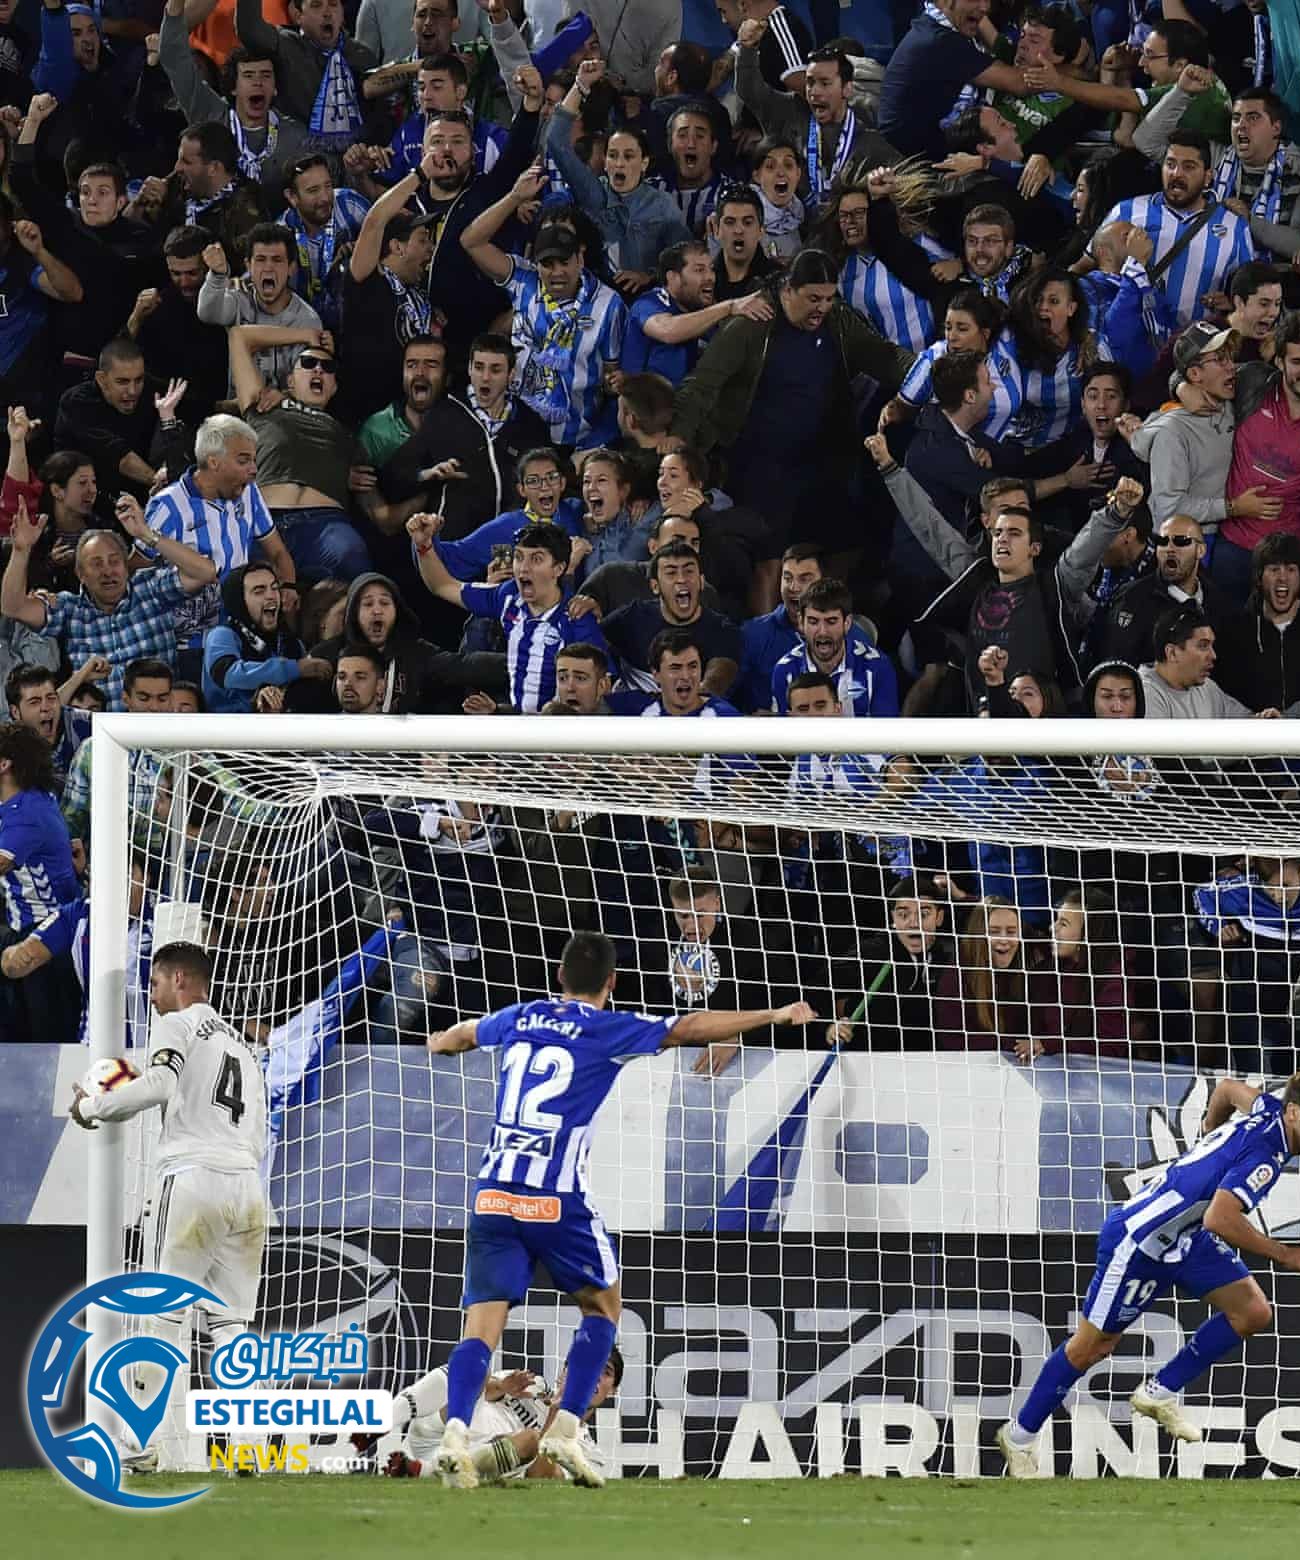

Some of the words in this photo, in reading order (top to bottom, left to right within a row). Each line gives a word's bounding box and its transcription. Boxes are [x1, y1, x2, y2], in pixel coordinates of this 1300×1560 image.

[211, 1050, 245, 1128] 4
[498, 1041, 575, 1130] 12
[1126, 1279, 1157, 1305] 19
